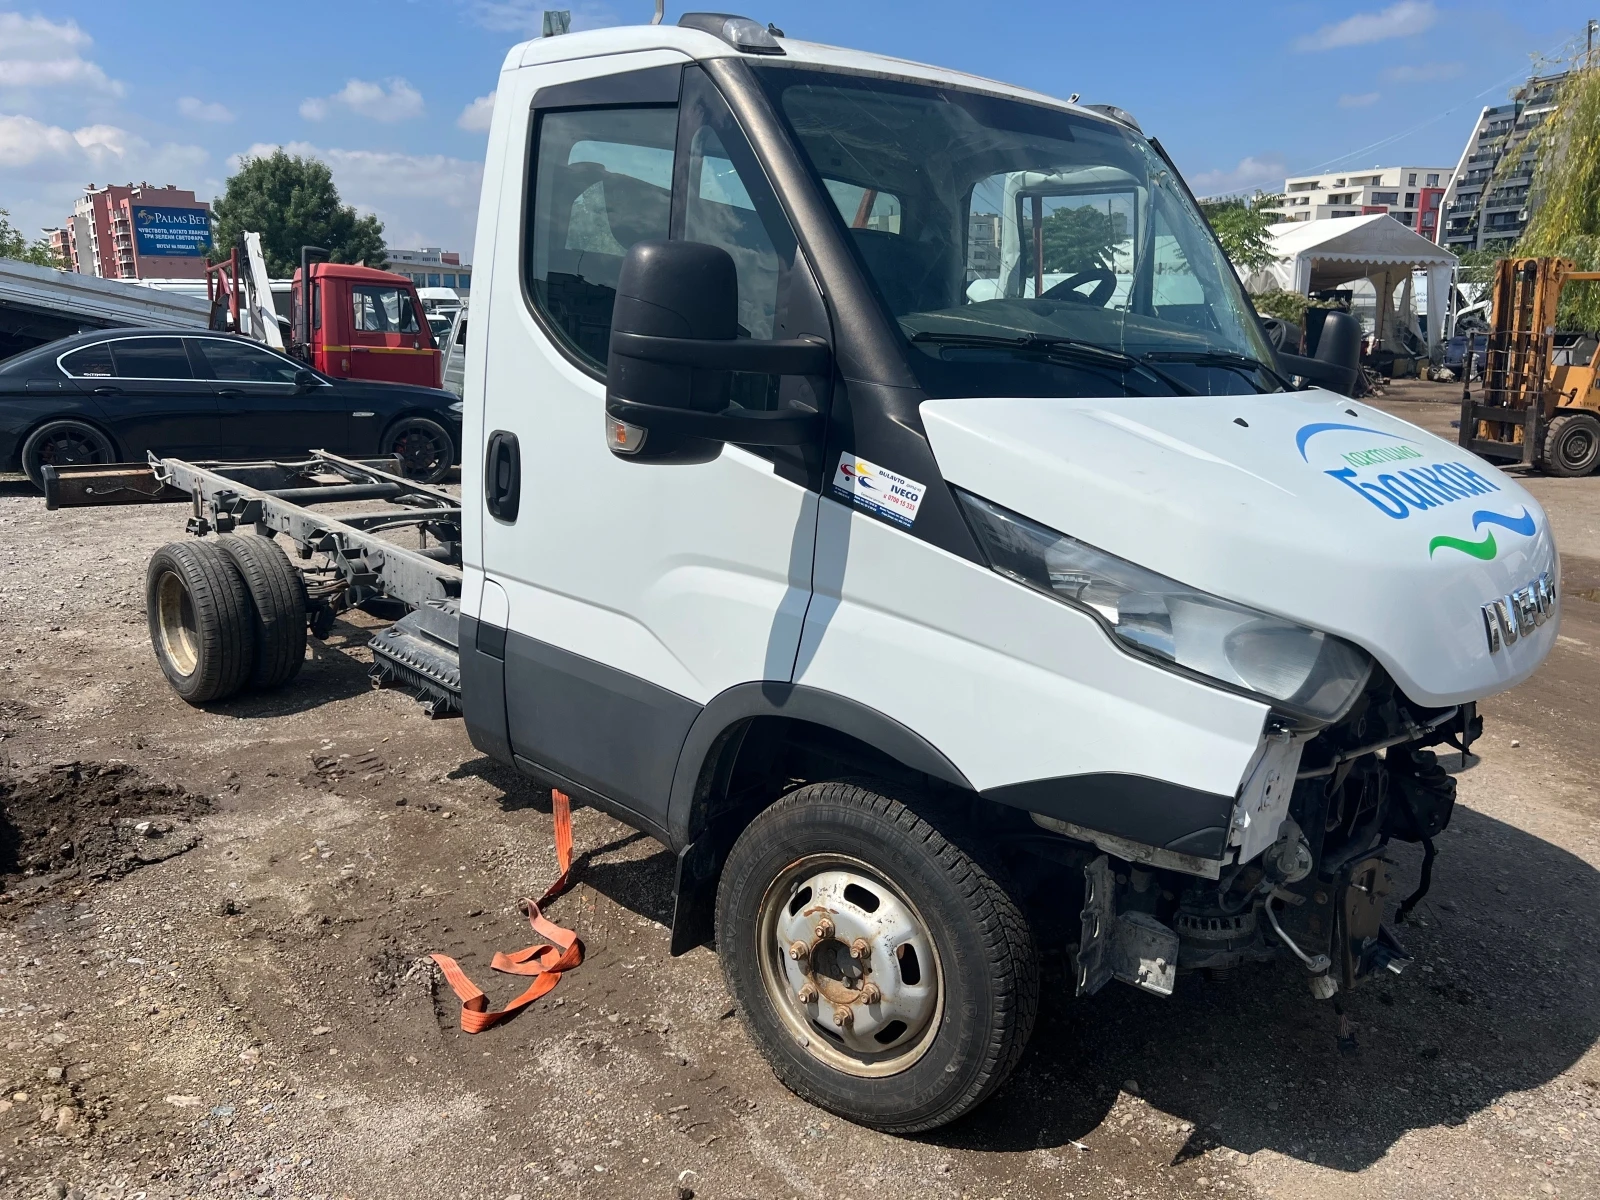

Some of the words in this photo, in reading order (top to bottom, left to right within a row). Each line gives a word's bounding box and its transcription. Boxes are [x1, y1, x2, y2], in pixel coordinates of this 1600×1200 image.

[878, 470, 905, 485] BULAVTO
[890, 484, 919, 502] IVECO
[1480, 571, 1556, 654] IVECO
